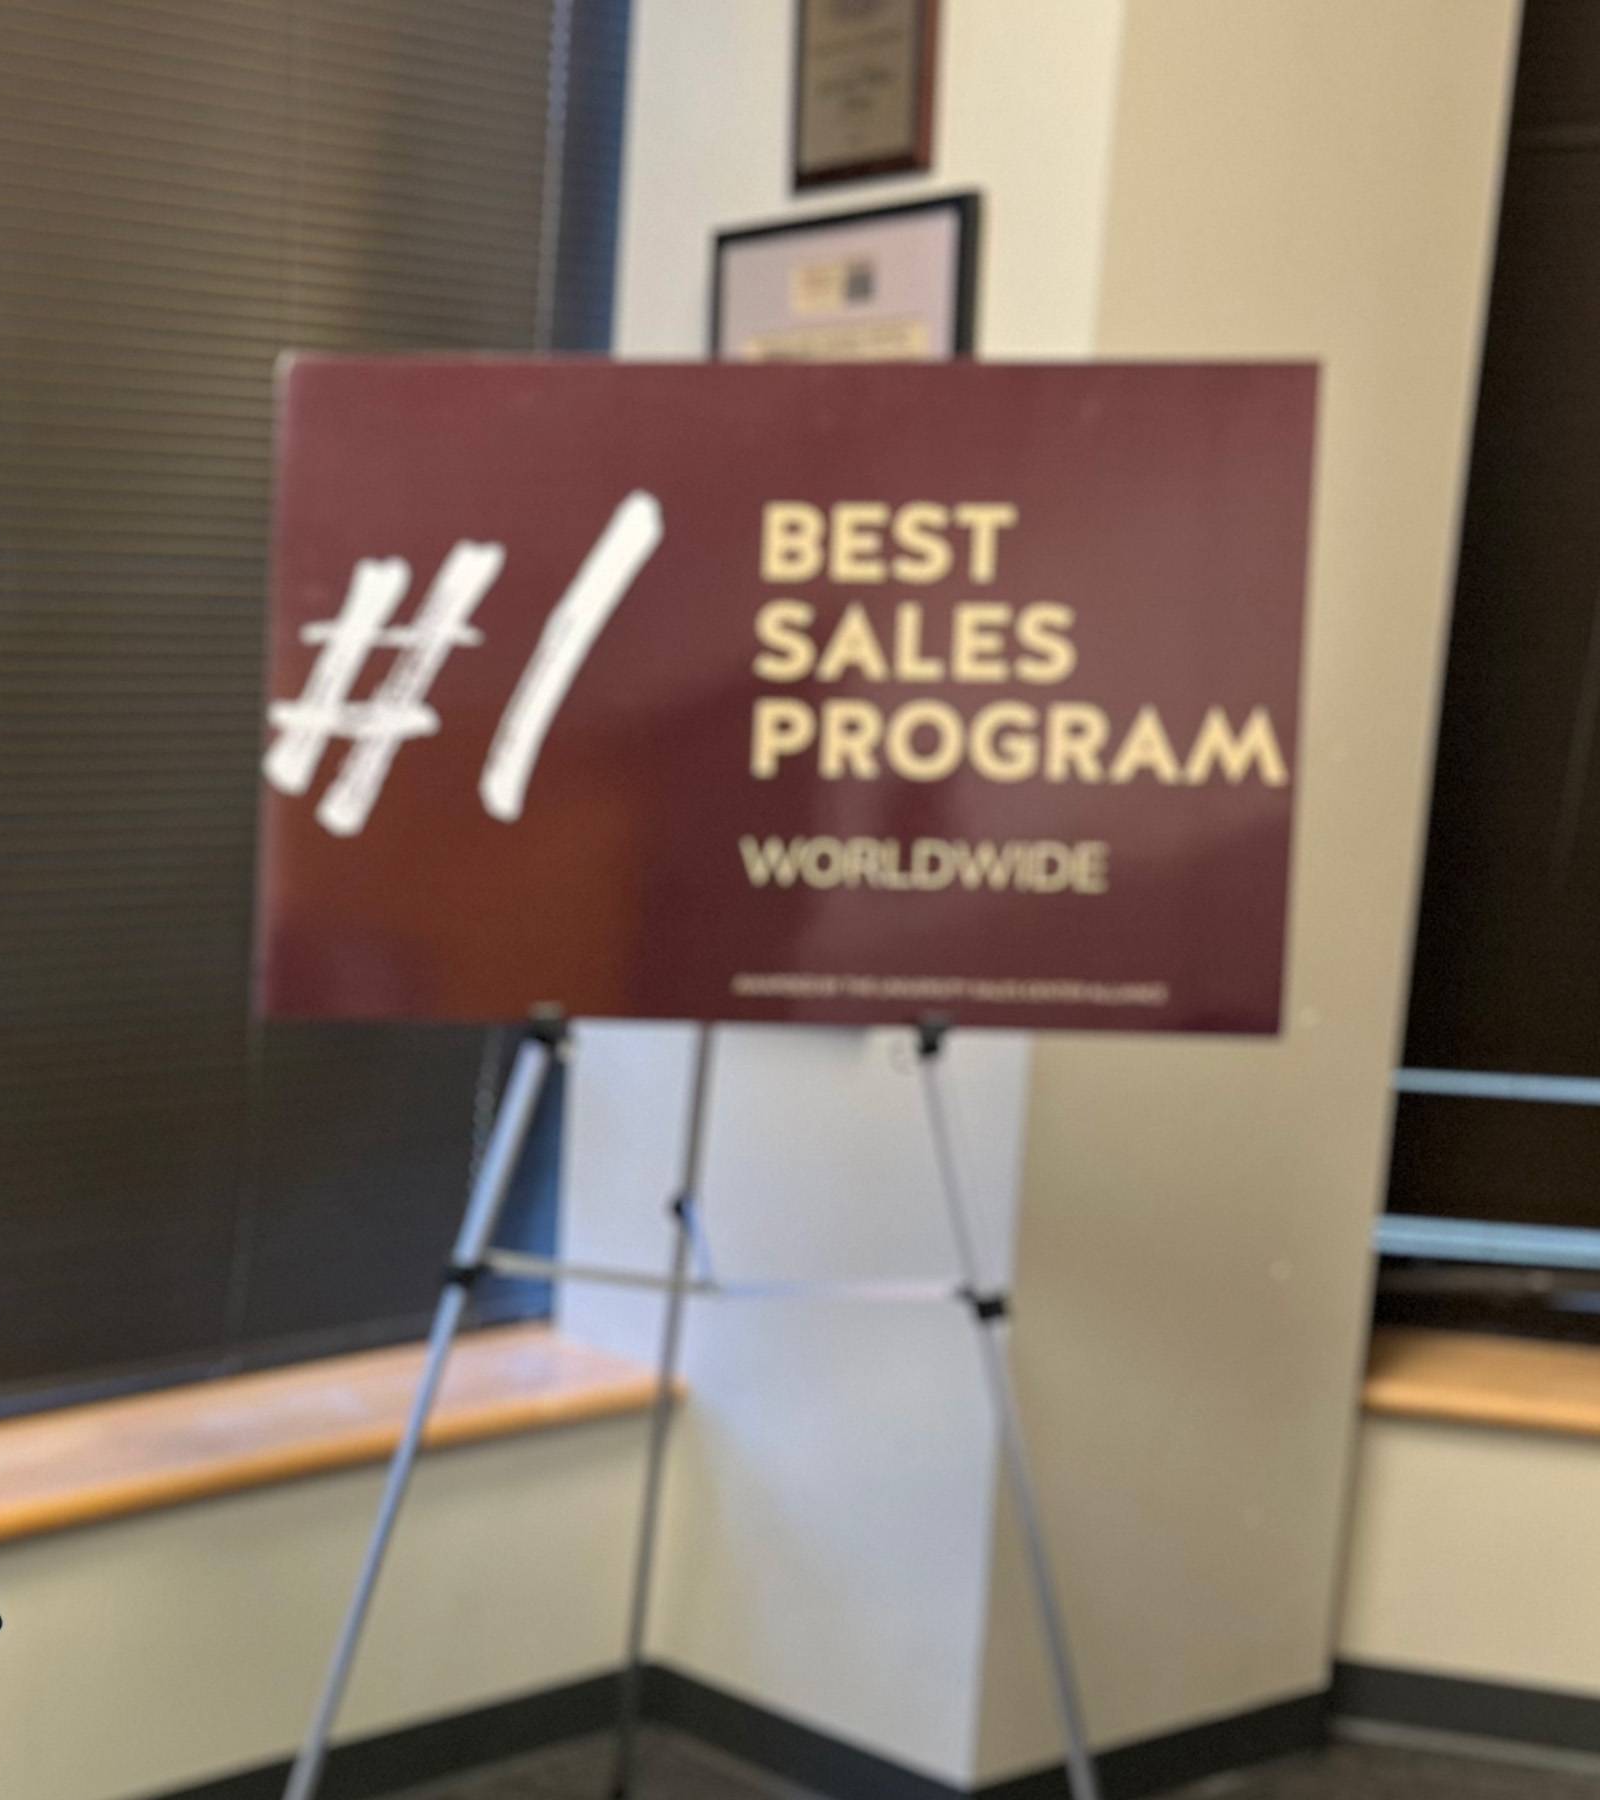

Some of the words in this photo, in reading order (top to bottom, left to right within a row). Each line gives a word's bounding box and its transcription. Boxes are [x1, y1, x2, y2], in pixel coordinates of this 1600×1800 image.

[762, 502, 1016, 583] BEST
[263, 490, 662, 836] #1
[757, 601, 1076, 683] SALES
[753, 699, 1286, 785] PROGRAM
[741, 836, 1108, 893] WORLDWIDE
